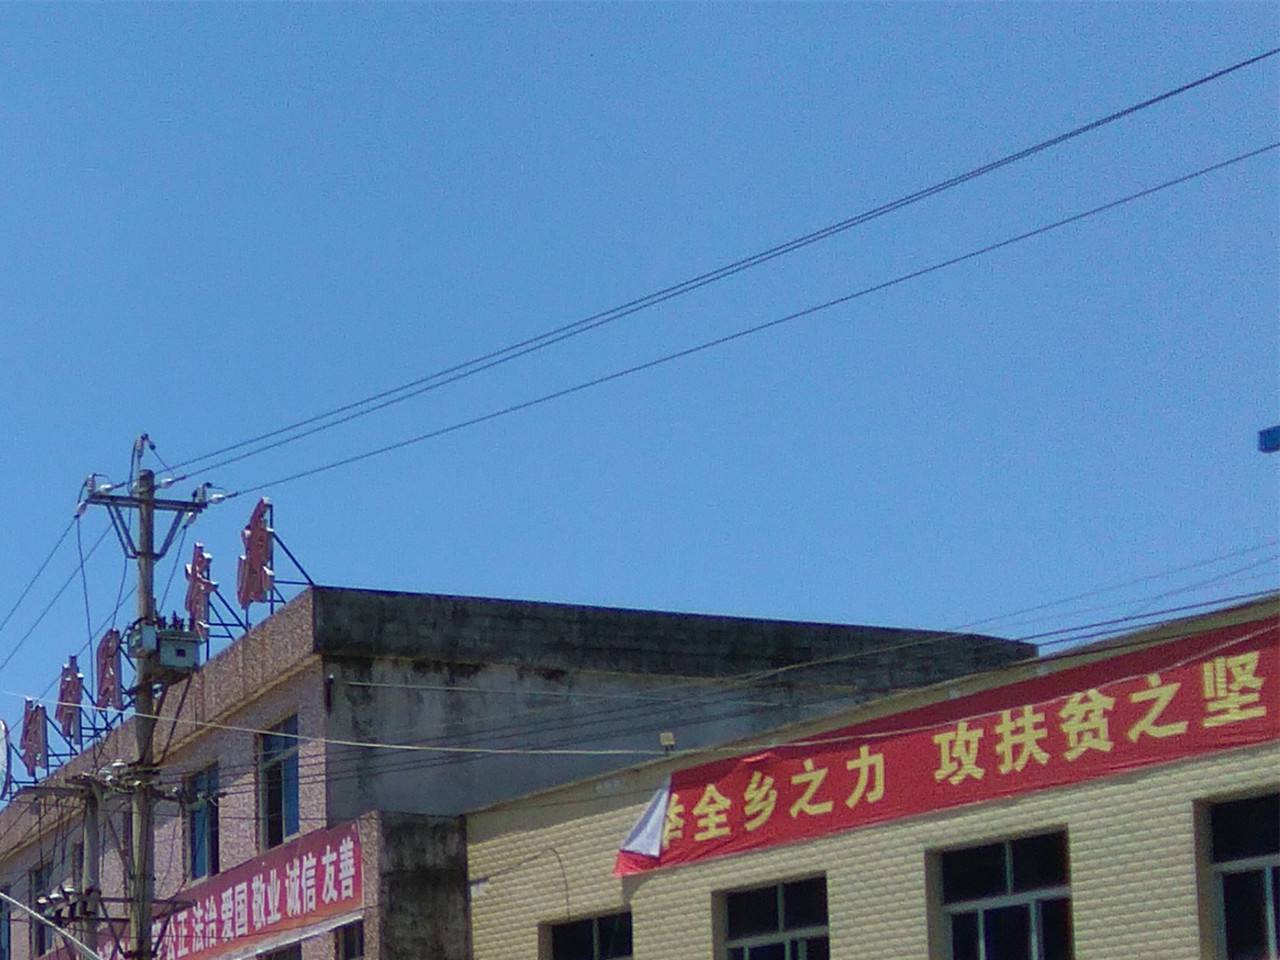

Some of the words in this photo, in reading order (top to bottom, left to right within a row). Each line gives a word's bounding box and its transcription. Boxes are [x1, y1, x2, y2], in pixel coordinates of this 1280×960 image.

[933, 651, 1267, 785] 攻扶贫之坚
